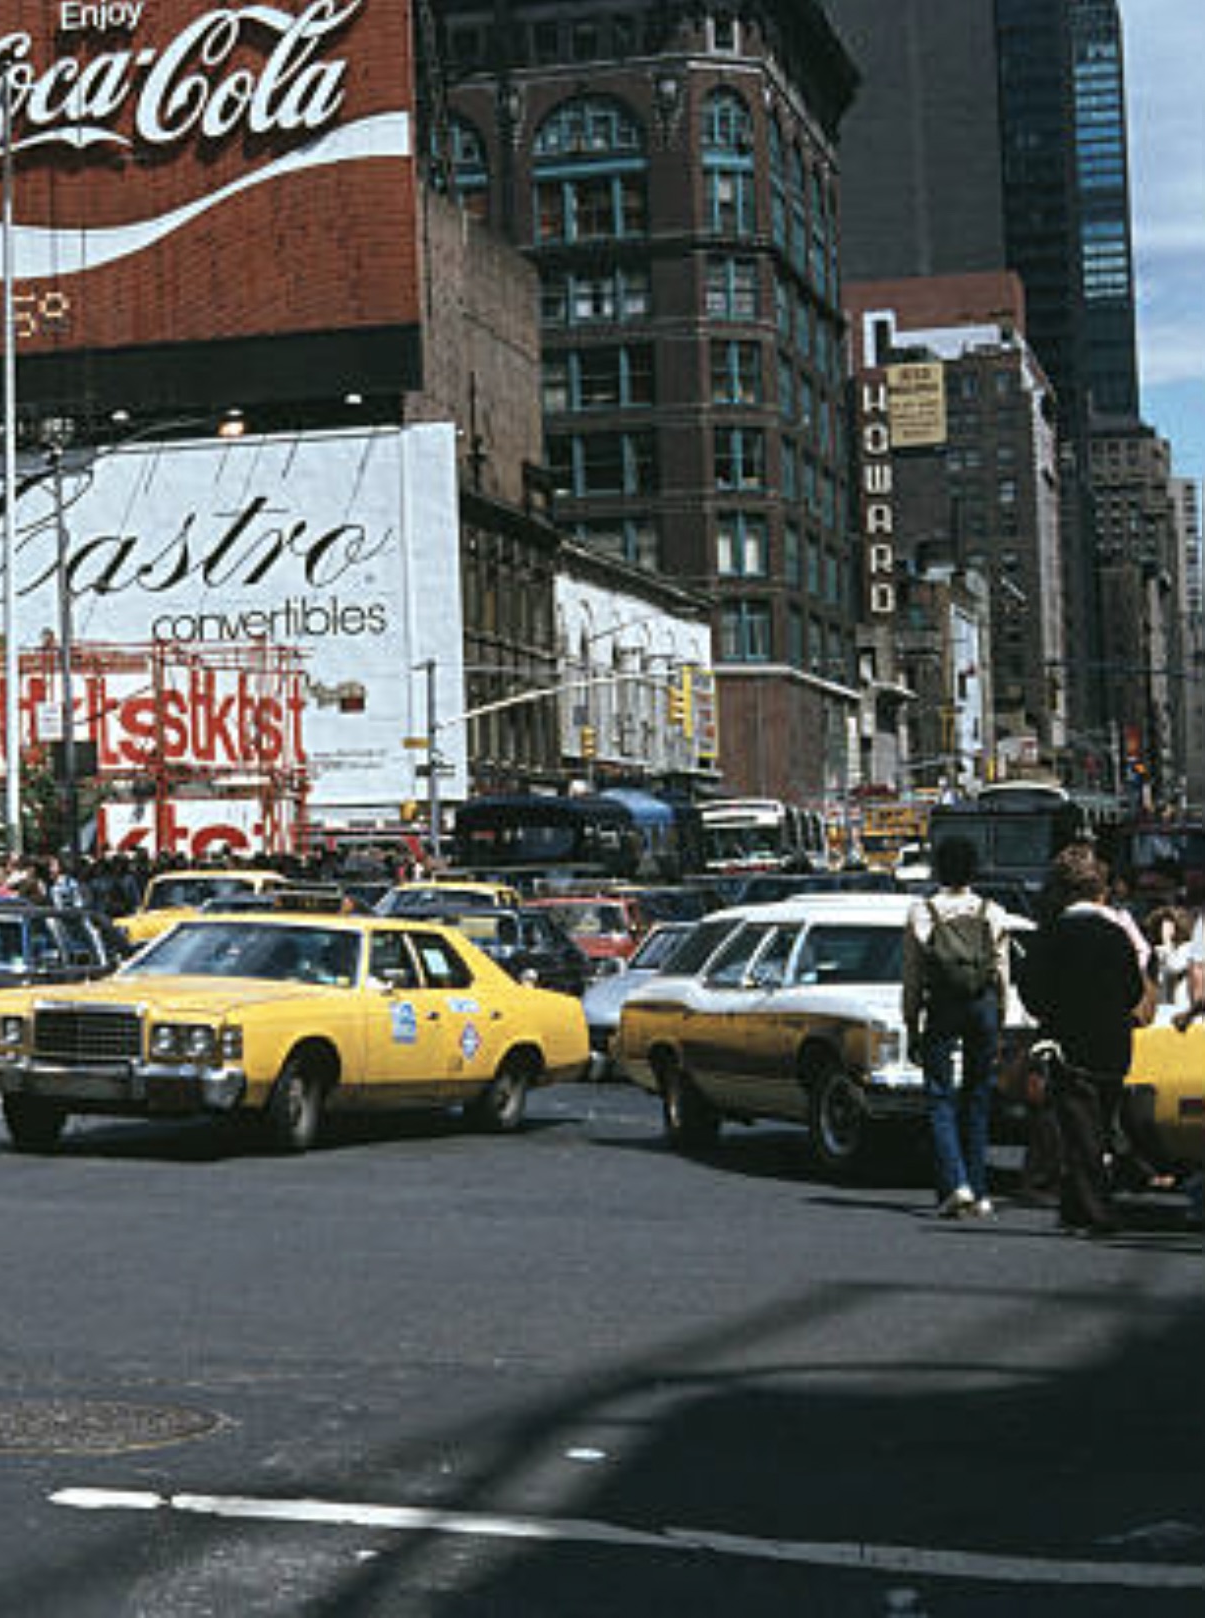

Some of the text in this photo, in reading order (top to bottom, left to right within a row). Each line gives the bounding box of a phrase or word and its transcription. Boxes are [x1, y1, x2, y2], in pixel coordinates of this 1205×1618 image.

[60, 0, 142, 31] Enjoy
[862, 382, 895, 613] HOWARD
[152, 596, 387, 643] convertibles
